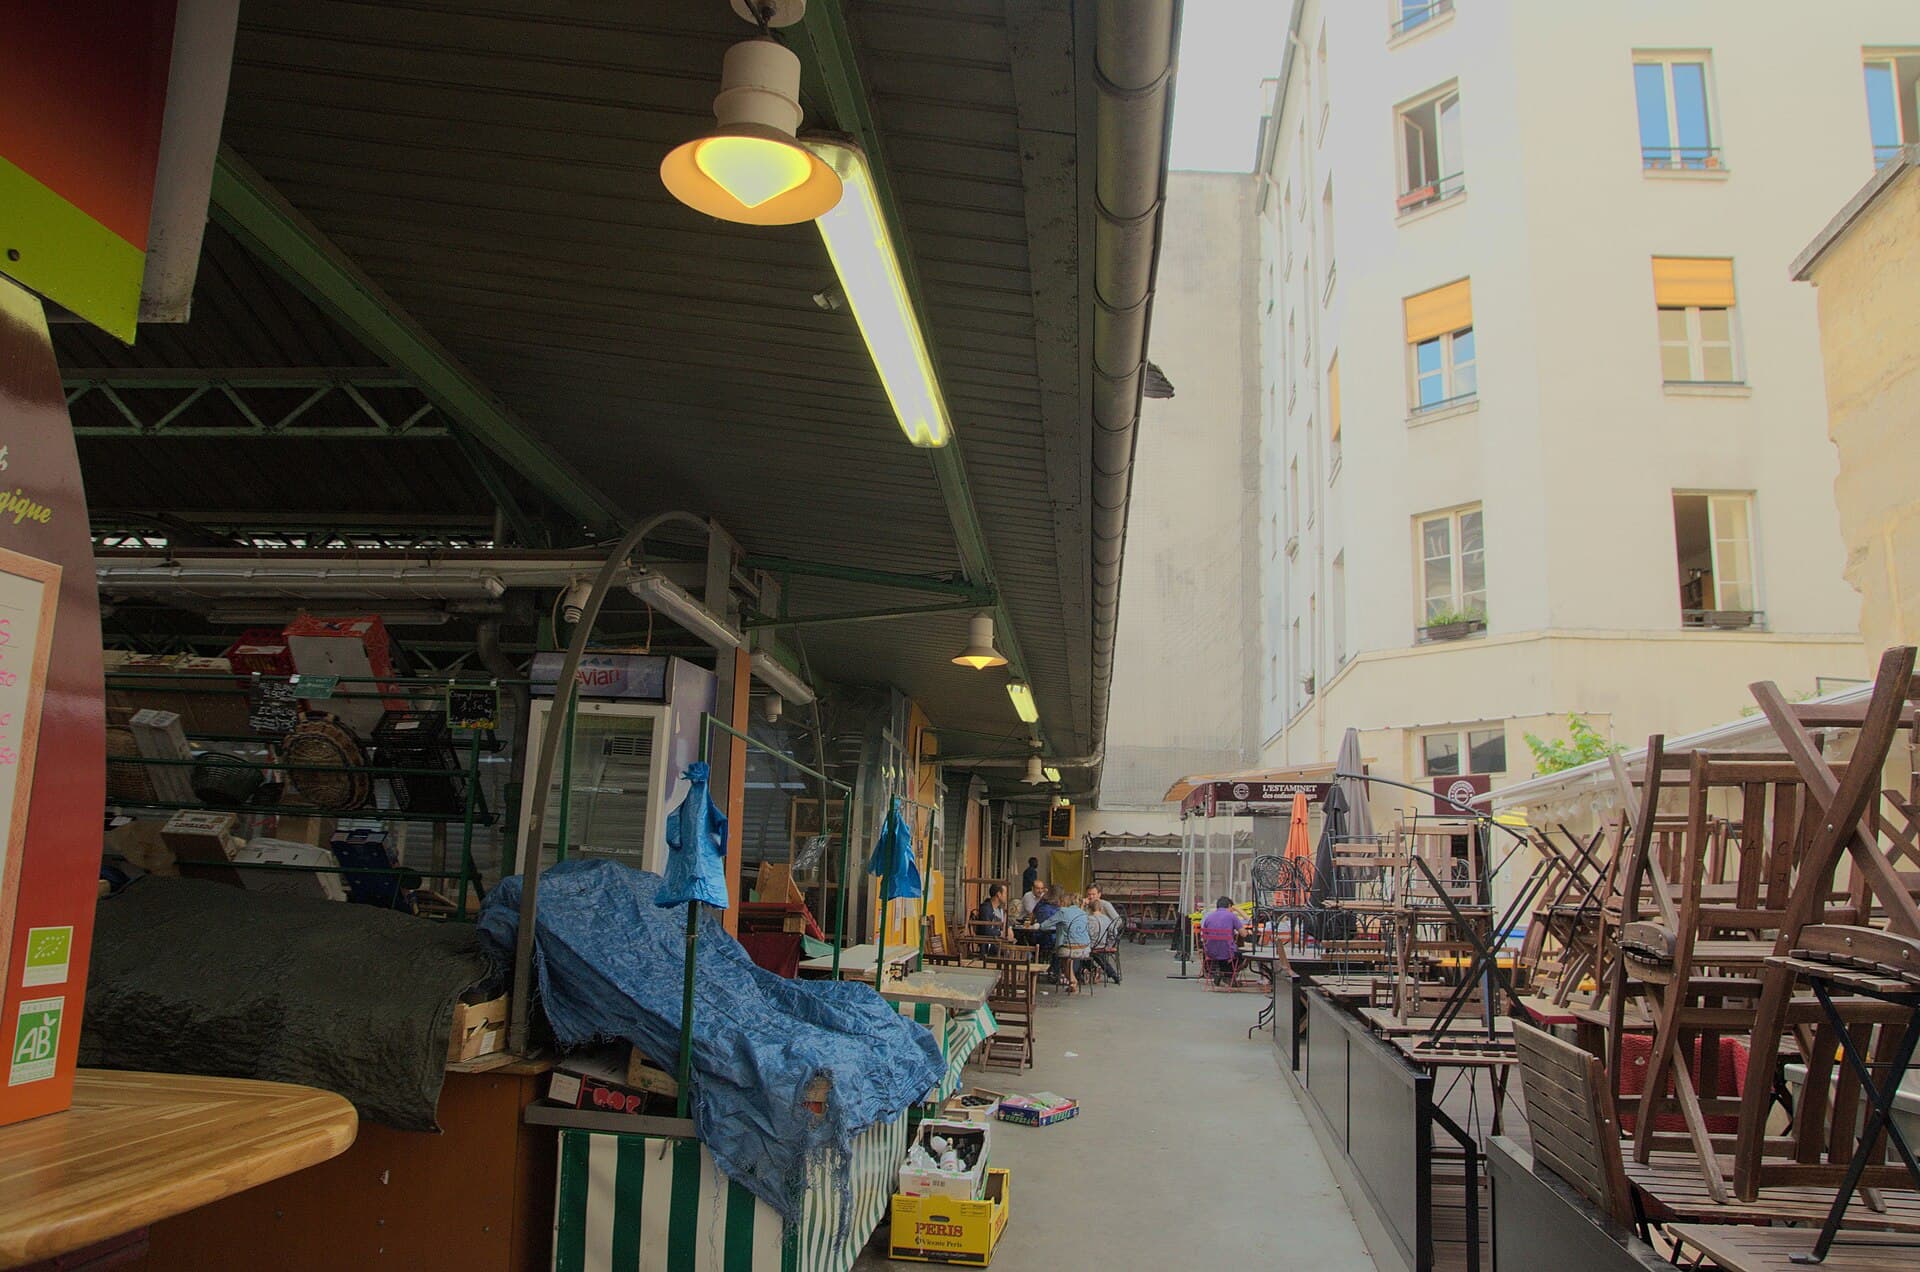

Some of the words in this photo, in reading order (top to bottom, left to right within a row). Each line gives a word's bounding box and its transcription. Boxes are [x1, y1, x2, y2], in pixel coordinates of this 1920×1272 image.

[576, 668, 620, 686] evian
[1262, 784, 1317, 792] L'ESTAMINET
[15, 1025, 51, 1063] AB
[915, 1222, 963, 1237] PERIS
